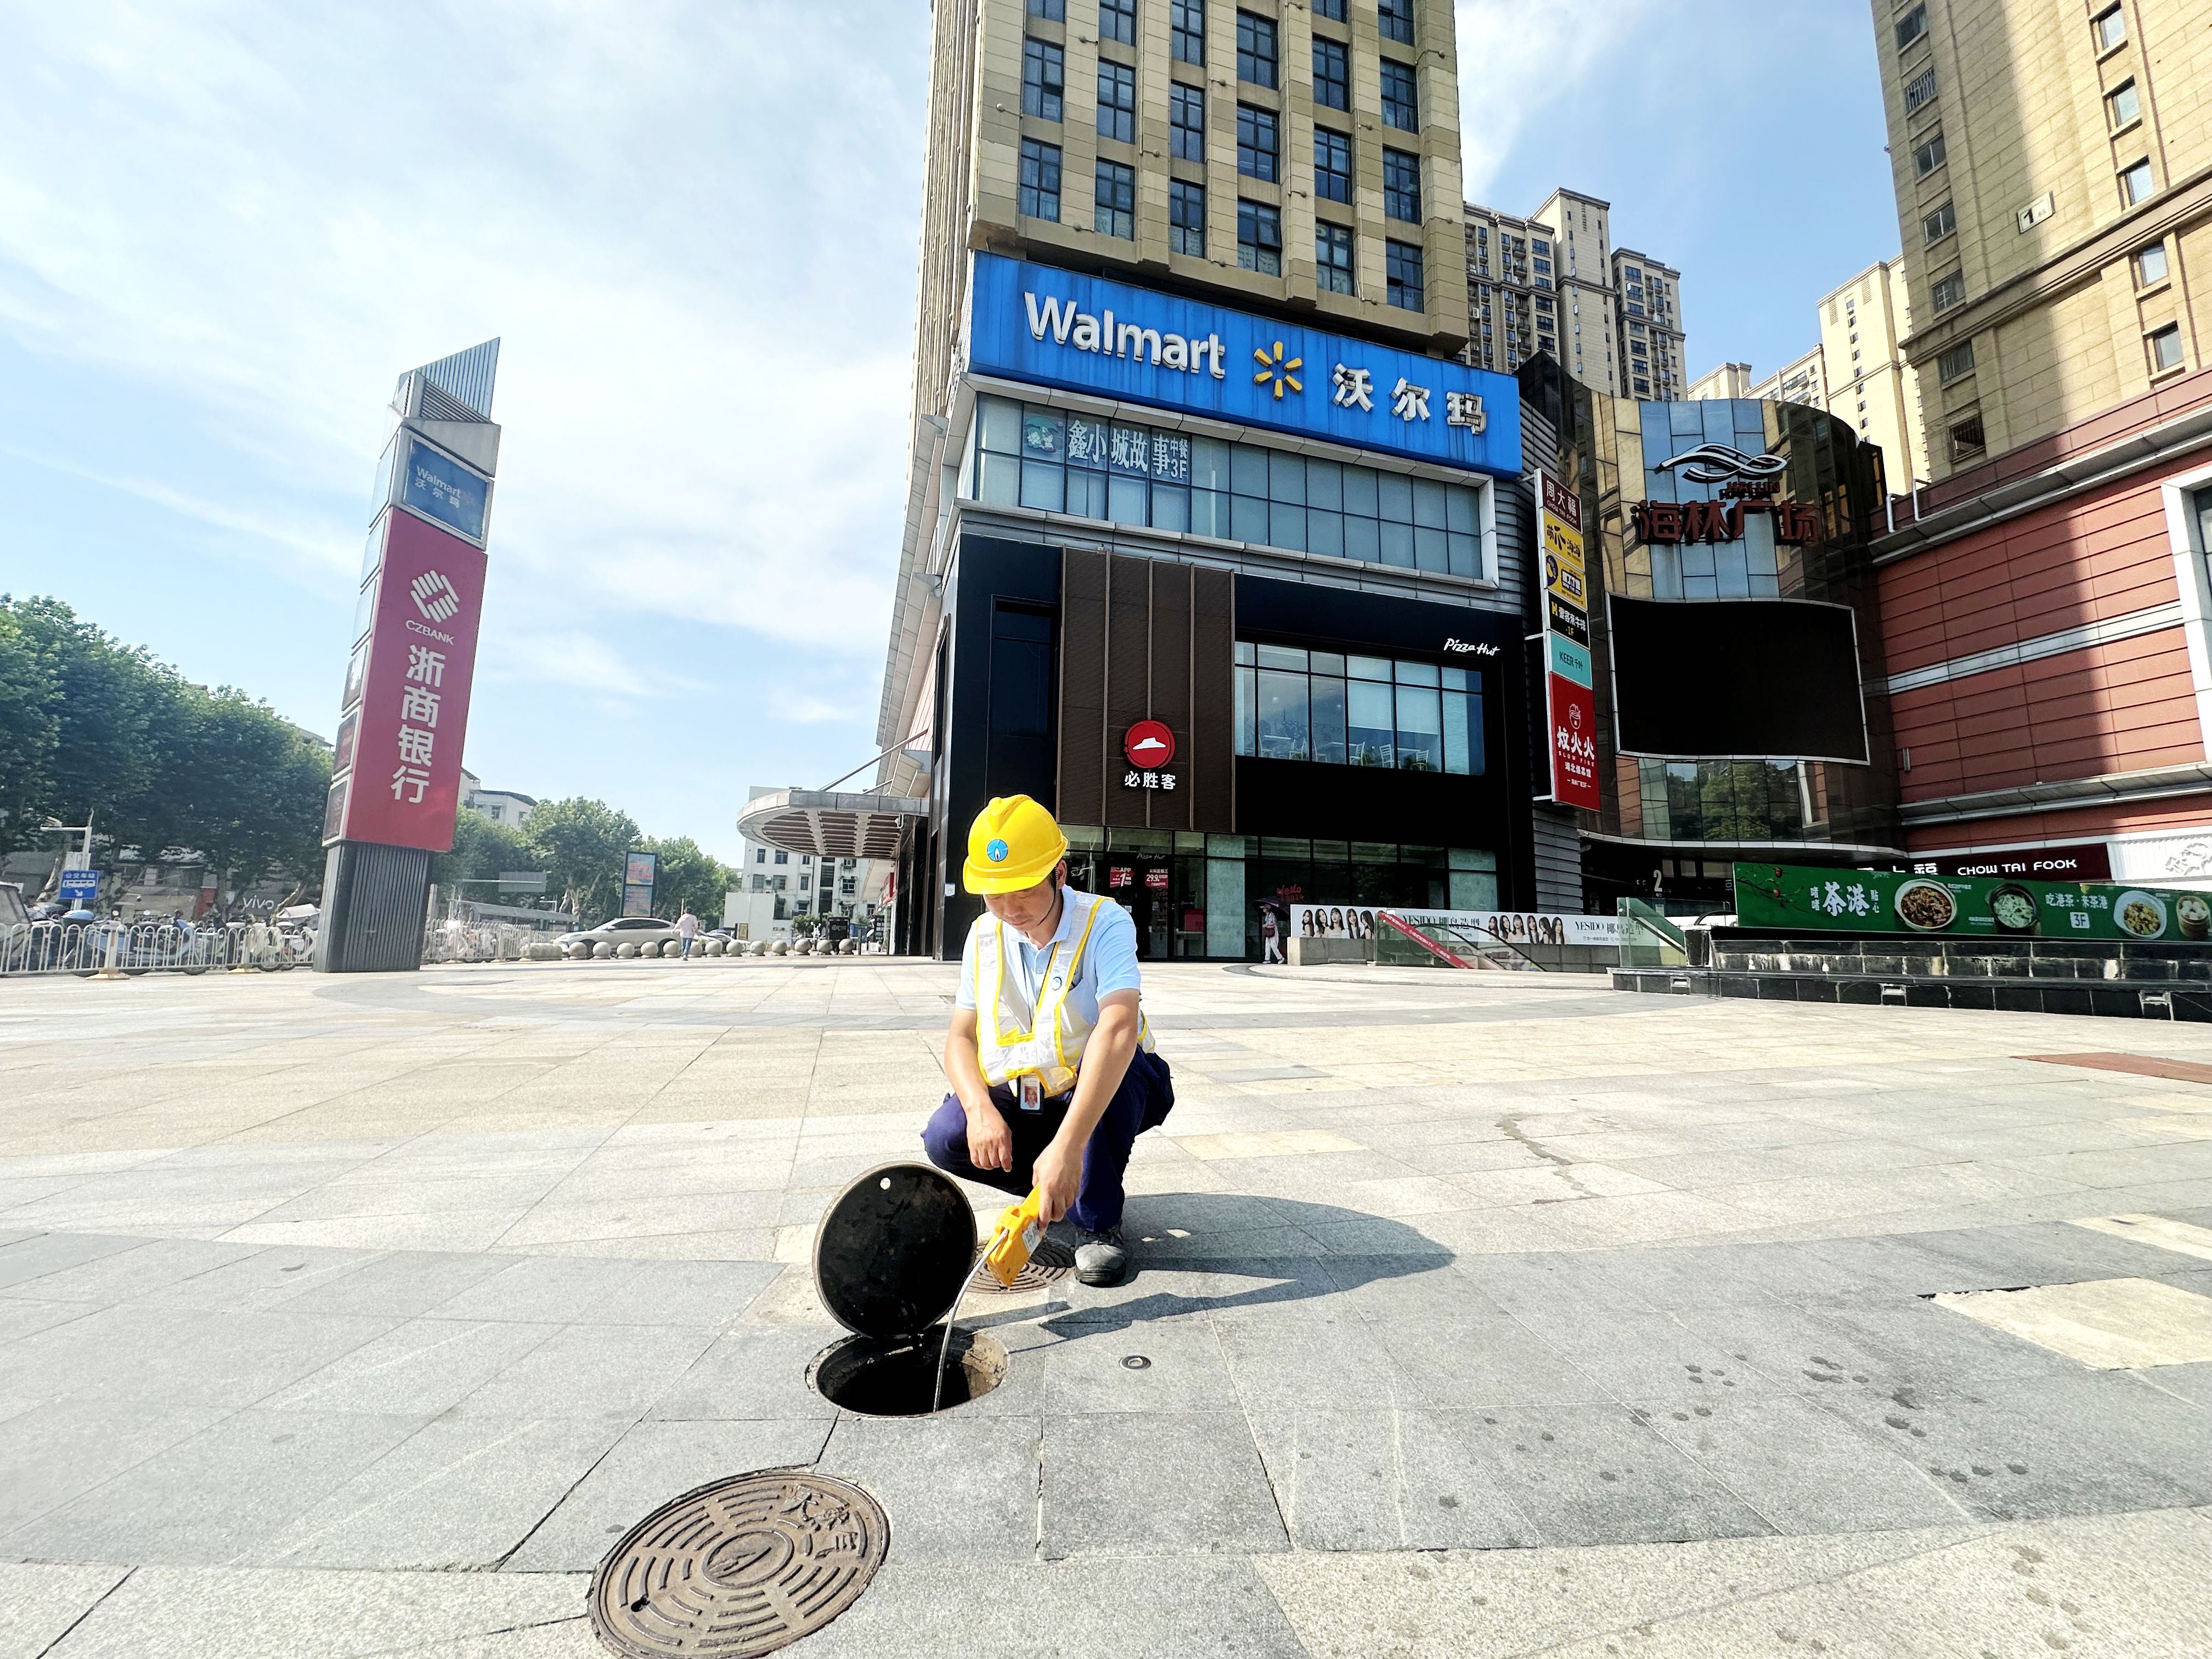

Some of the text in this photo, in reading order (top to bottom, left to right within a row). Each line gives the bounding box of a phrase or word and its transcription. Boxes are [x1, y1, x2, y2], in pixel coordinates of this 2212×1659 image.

[1024, 291, 1226, 379] Walmart
[1332, 363, 1487, 435] 沃尔玛
[1068, 419, 1170, 475] 鑫小城故事
[1170, 437, 1188, 459] 中餐
[416, 465, 461, 498] Walmart
[1170, 460, 1187, 479] 3F
[414, 476, 460, 509] 沃尔玛
[1546, 480, 1577, 517] 周大福
[1630, 499, 1818, 542] 海林广场
[406, 620, 455, 646] CZBANK
[1443, 638, 1500, 656] Pizza Hut
[1559, 651, 1574, 667] KEER
[391, 644, 446, 804] 浙商银行
[1124, 771, 1176, 790] 必胜客
[1957, 859, 2078, 876] CHOW TAI FOOK
[242, 895, 274, 910] vivo
[1822, 881, 1870, 917] 茶港
[1575, 921, 1604, 931] YESIDO
[2074, 913, 2087, 927] 3F
